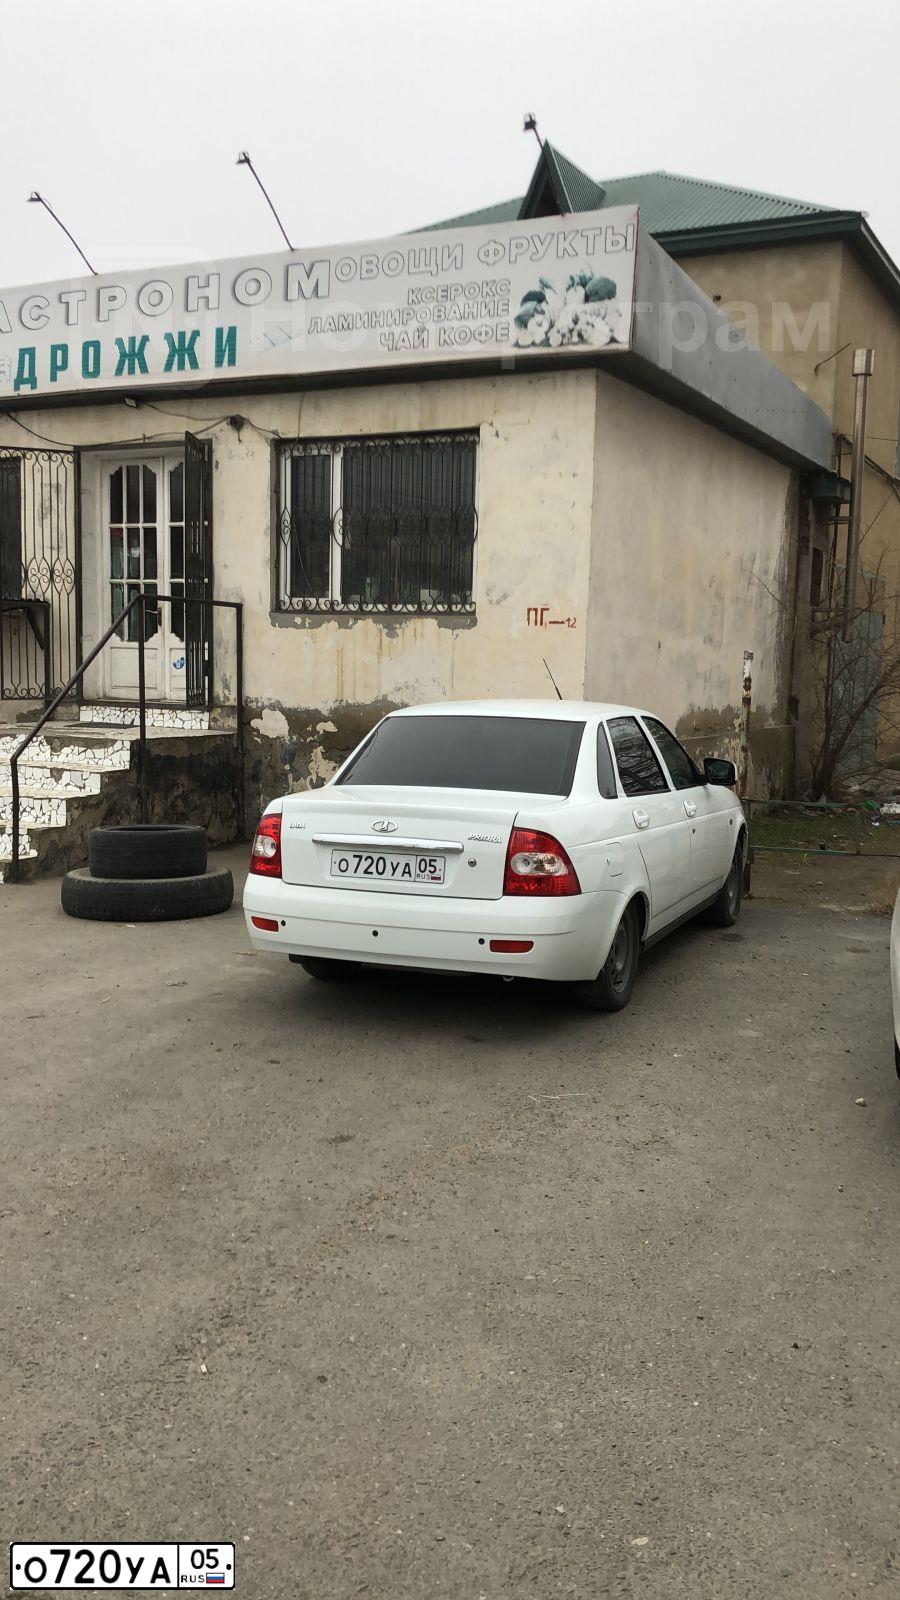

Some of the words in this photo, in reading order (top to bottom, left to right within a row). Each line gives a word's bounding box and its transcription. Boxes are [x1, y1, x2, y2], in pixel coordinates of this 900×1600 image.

[334, 243, 464, 282] ОВОЩИ
[477, 224, 635, 266] ФРУКТЫ
[407, 278, 511, 306] КСЕРОКС
[308, 298, 510, 335] ЛАМИНИРОВАНИЕ
[380, 324, 429, 352] ЧАЙ
[438, 322, 510, 347] КОФЕ
[13, 326, 237, 392] ДРОЖЖИ
[418, 858, 437, 874] 05
